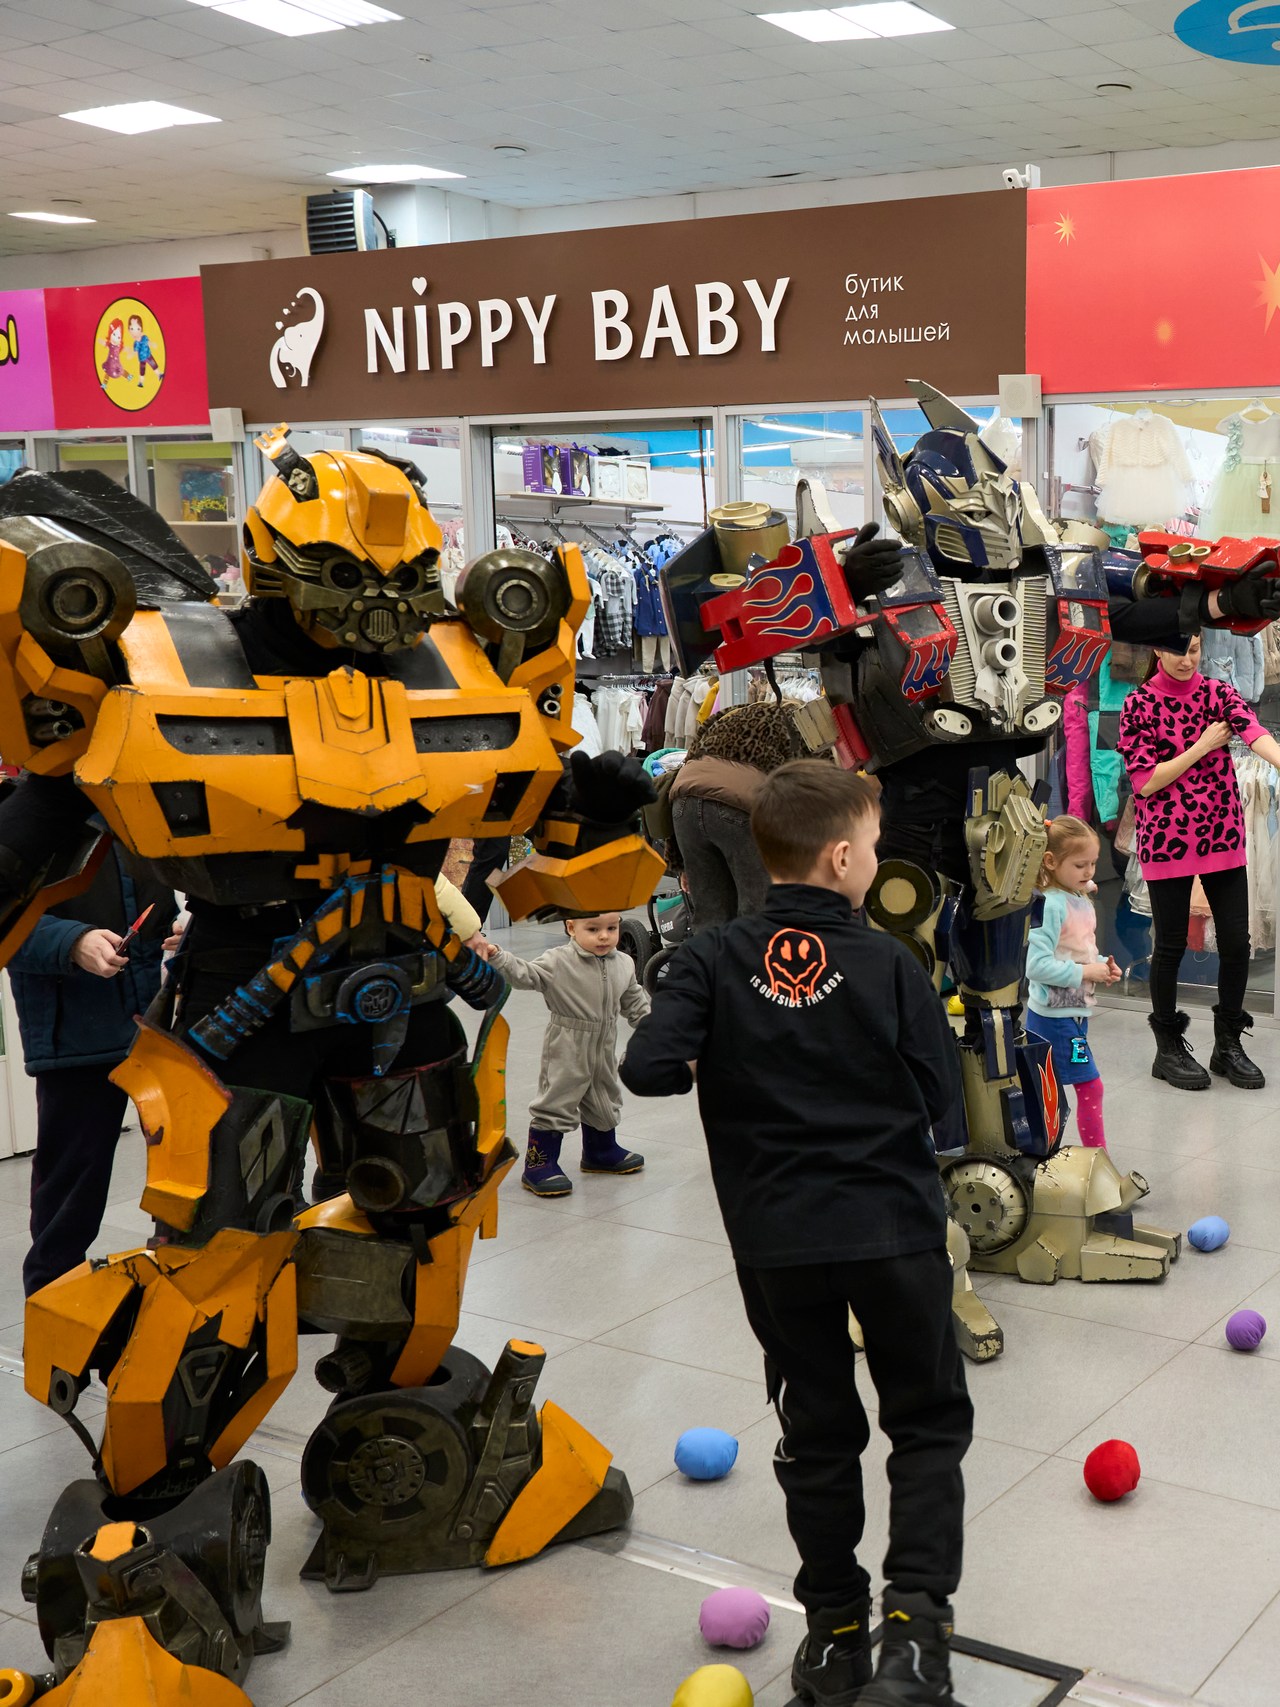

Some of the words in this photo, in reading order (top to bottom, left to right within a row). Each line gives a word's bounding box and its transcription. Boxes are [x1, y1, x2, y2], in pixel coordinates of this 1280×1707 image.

[845, 273, 905, 299] бутик
[591, 276, 791, 361] BABY
[845, 303, 879, 323] для
[843, 322, 950, 346] малышей
[749, 974, 761, 988] IS
[758, 984, 803, 1008] OUTSIDE
[804, 990, 825, 1007] THE
[821, 971, 844, 994] BOX
[1071, 1037, 1089, 1063] E
